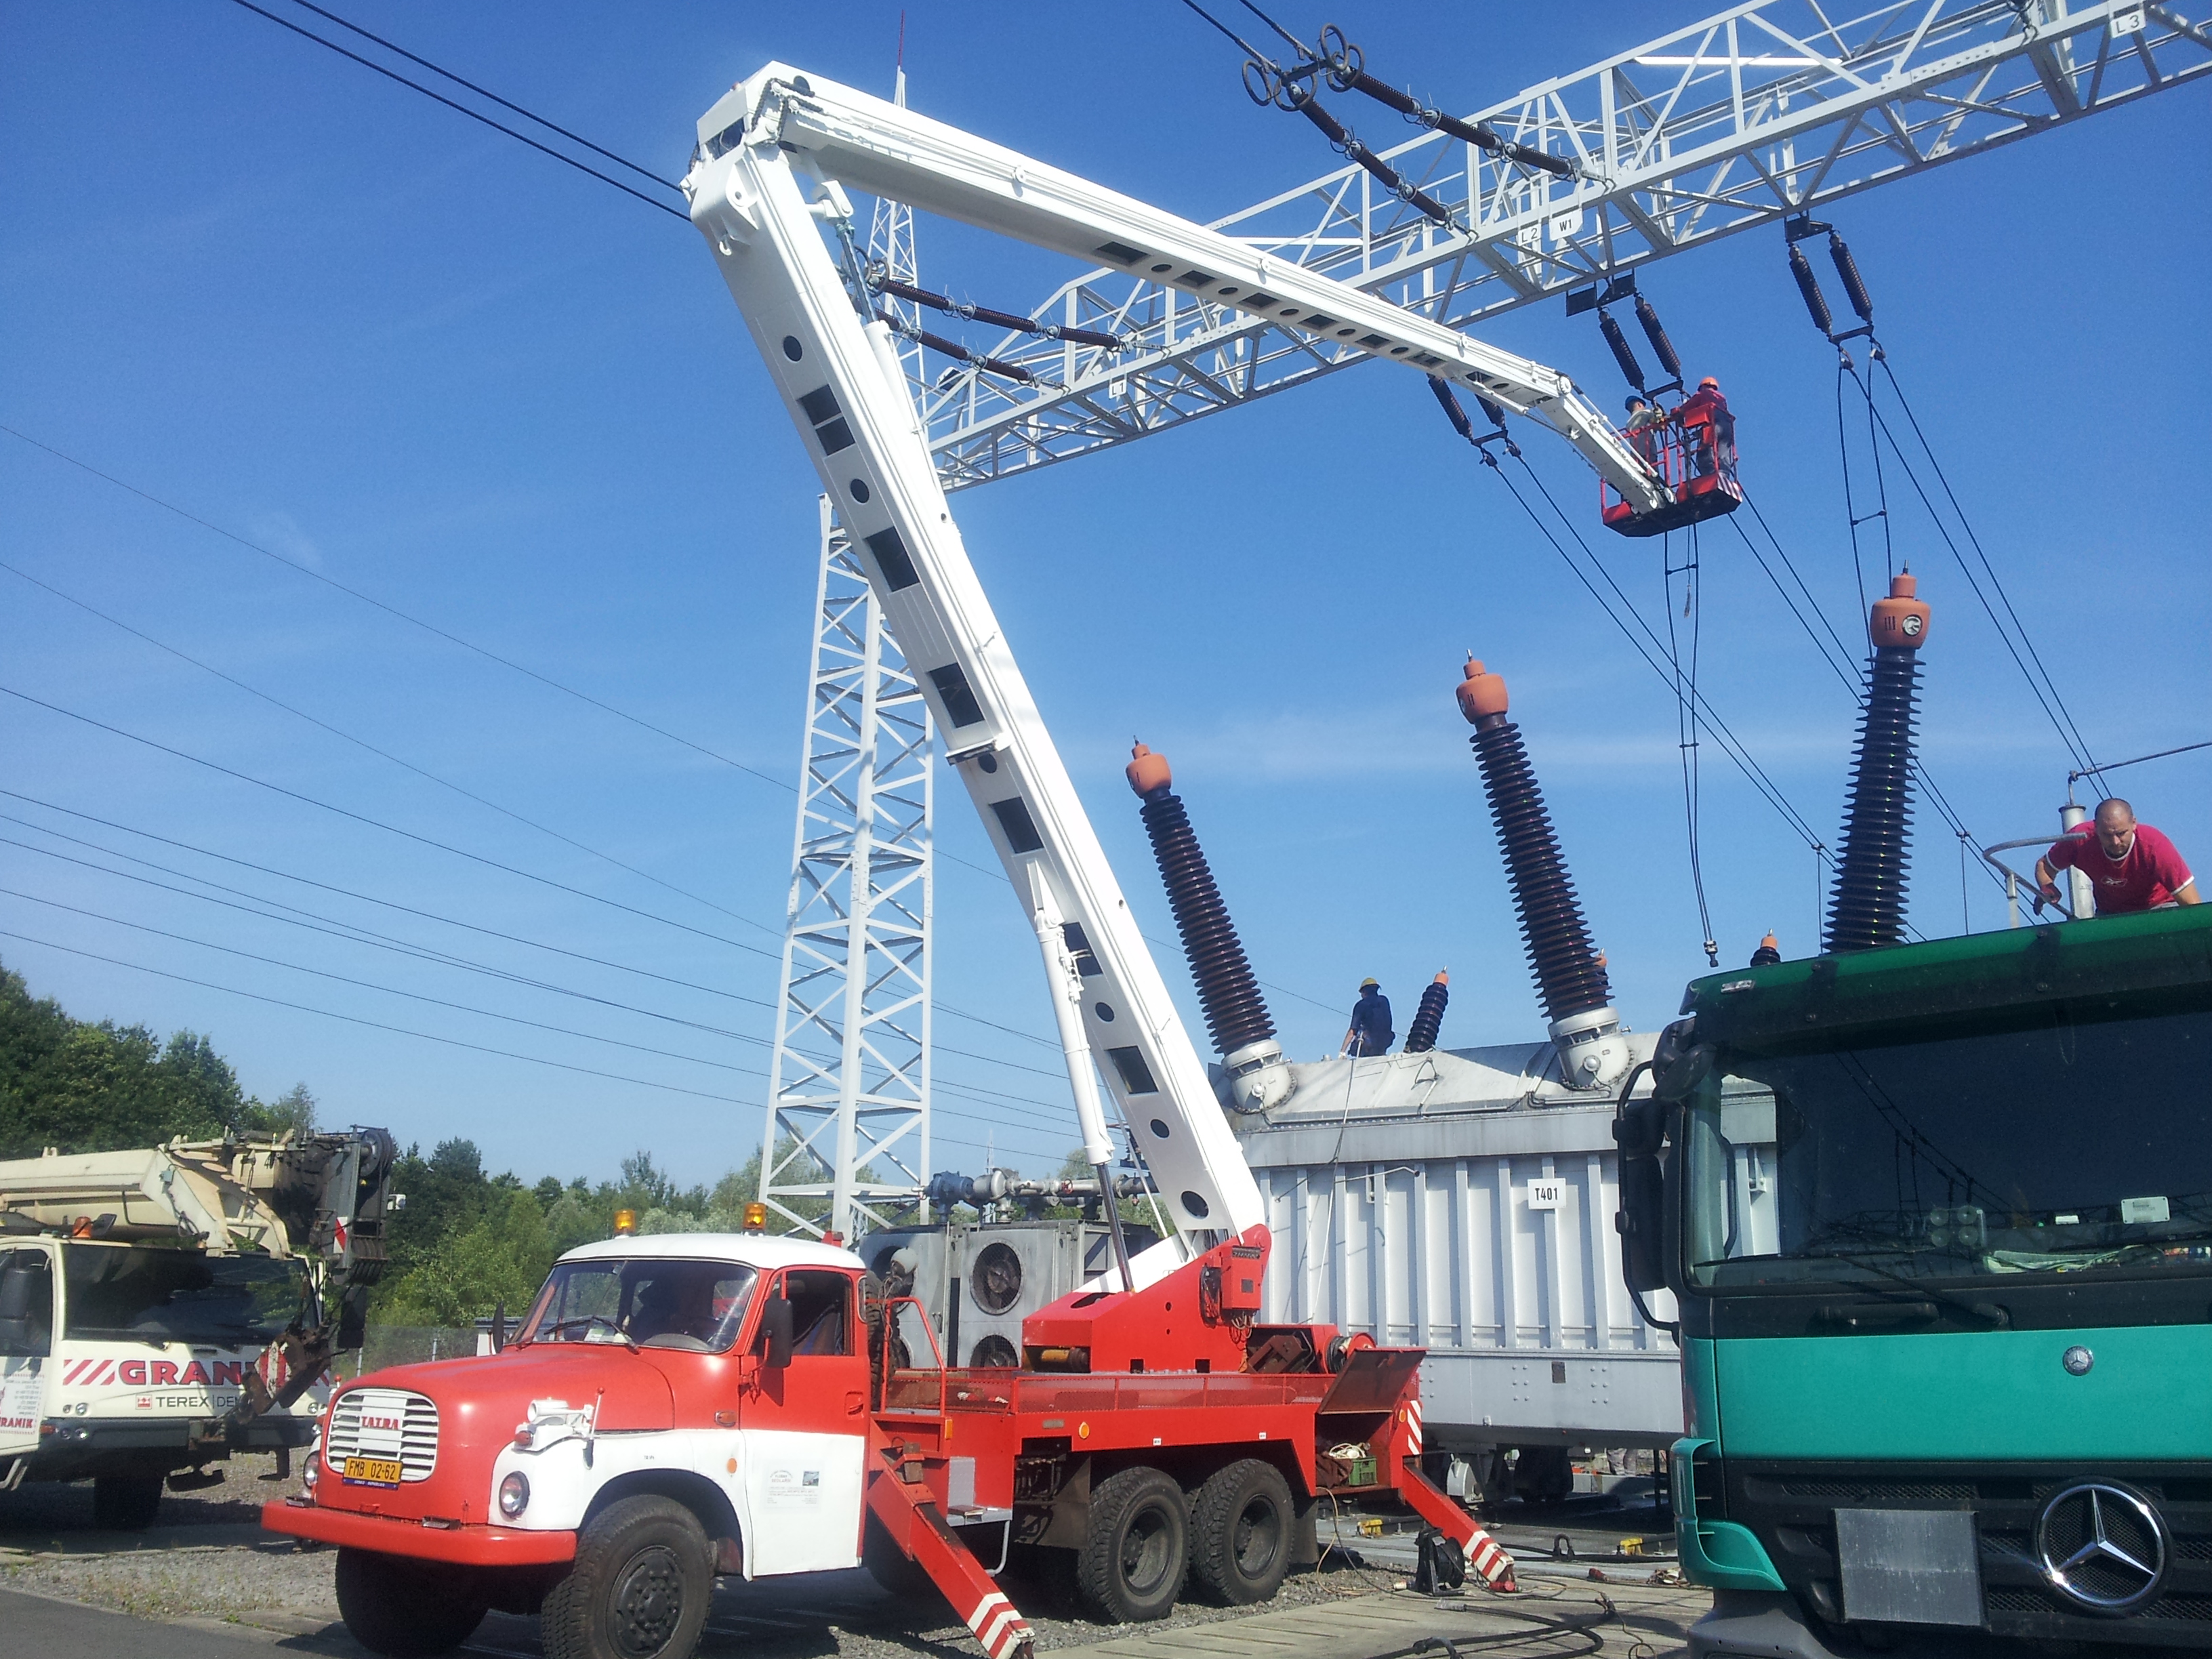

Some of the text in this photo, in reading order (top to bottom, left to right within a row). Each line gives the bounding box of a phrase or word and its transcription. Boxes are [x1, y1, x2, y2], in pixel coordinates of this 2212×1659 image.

[1559, 219, 1572, 232] W1
[1535, 1187, 1558, 1201] T401
[119, 1359, 254, 1386] GRAN
[155, 1396, 237, 1408] TEREX DE
[0, 1416, 33, 1429] RANIK
[361, 1416, 400, 1430] TATRA
[348, 1460, 396, 1480] FMB 02-62
